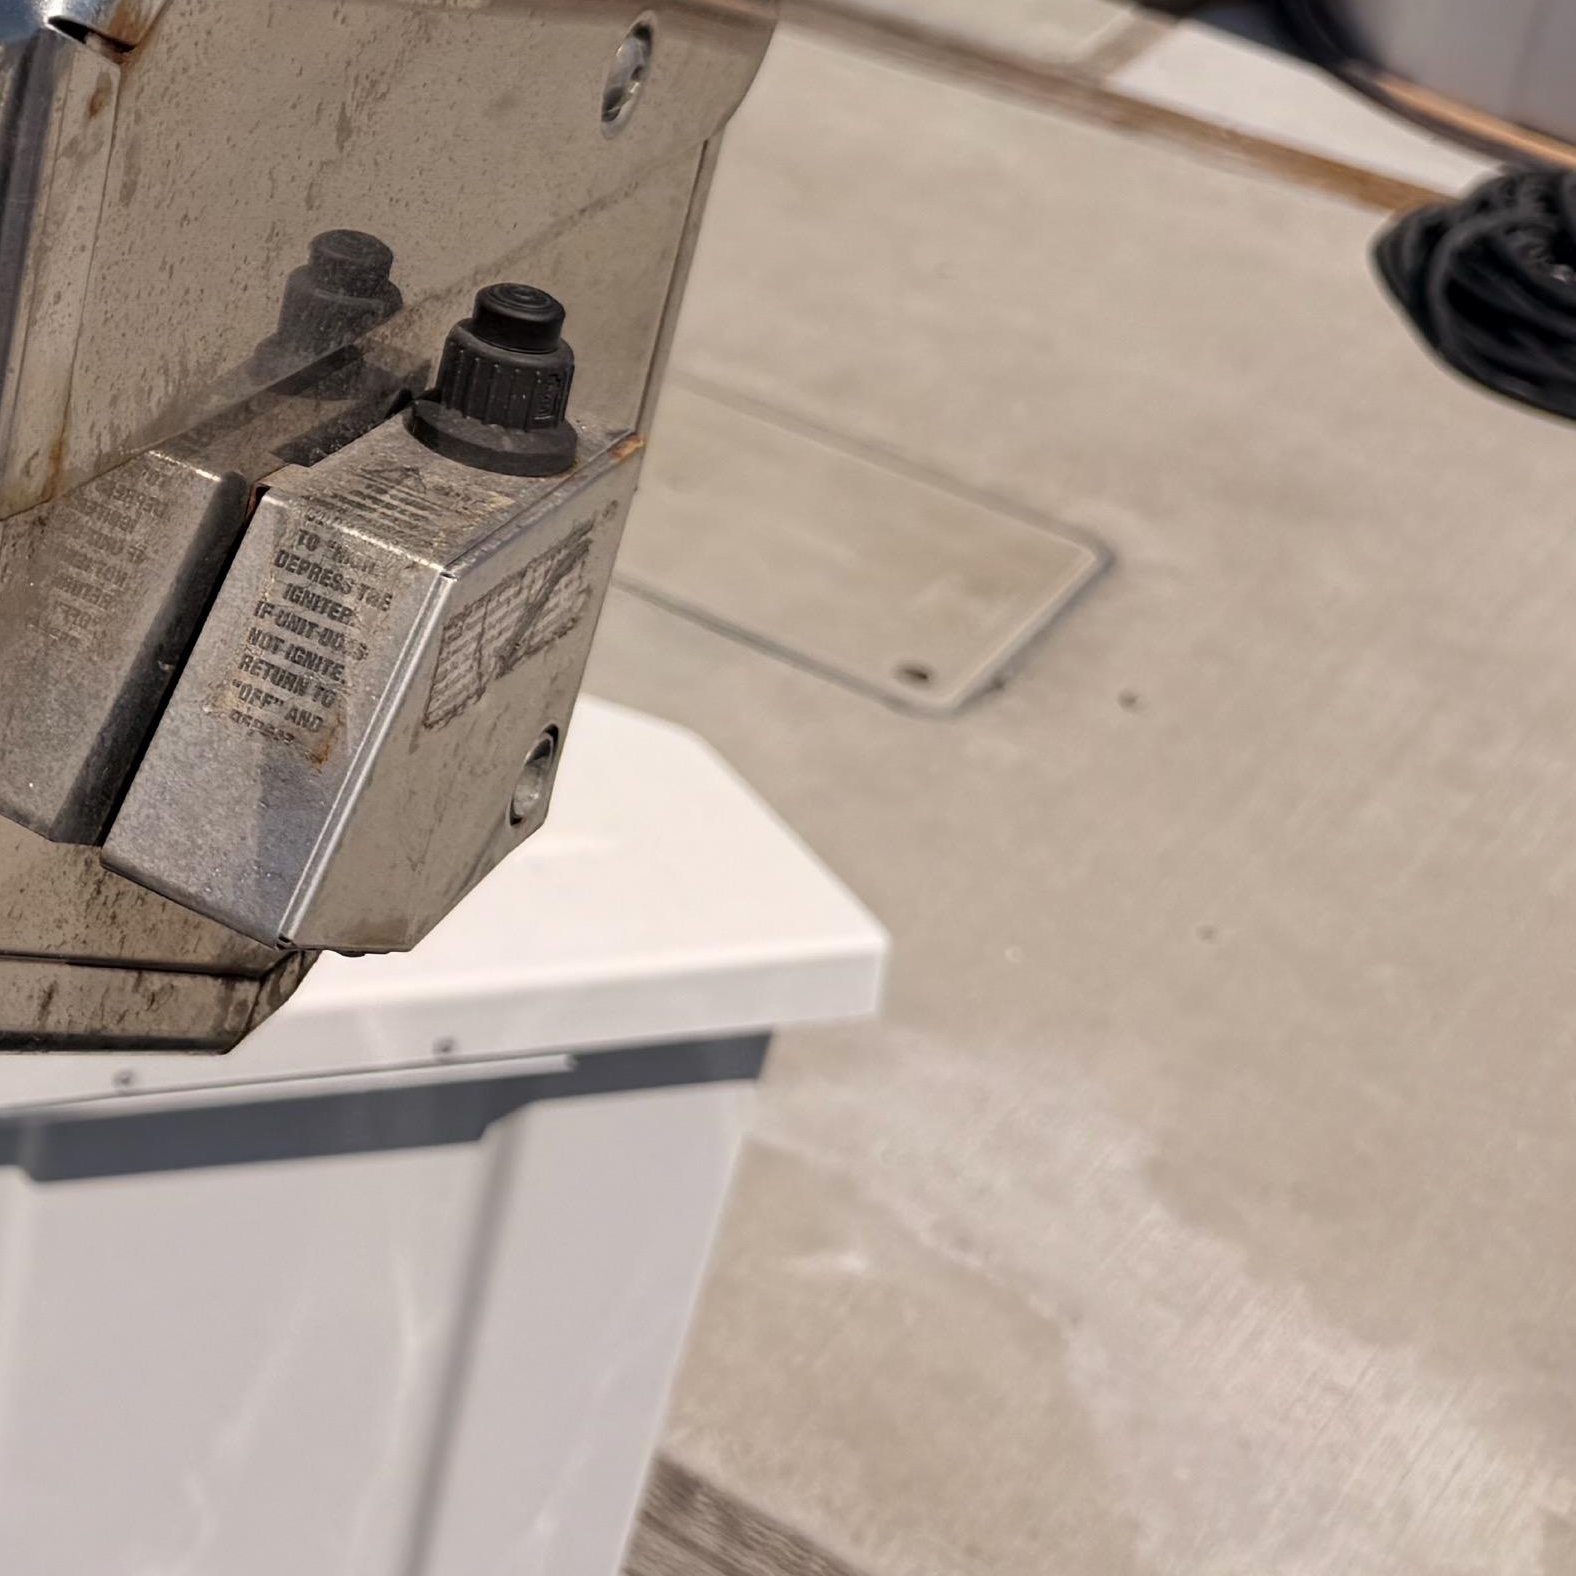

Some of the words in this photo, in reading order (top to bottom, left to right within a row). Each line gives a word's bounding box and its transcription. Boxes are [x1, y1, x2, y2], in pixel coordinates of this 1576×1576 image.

[298, 528, 321, 552] TO
[274, 550, 354, 595] DEPRESS
[248, 626, 285, 654] NOT
[285, 643, 345, 684] IGNITE.
[253, 600, 275, 619] IF
[275, 609, 319, 639] UNIT
[318, 627, 369, 661] DOS
[238, 653, 310, 697] RETURN
[312, 686, 337, 709] TO
[284, 706, 324, 734] AND
